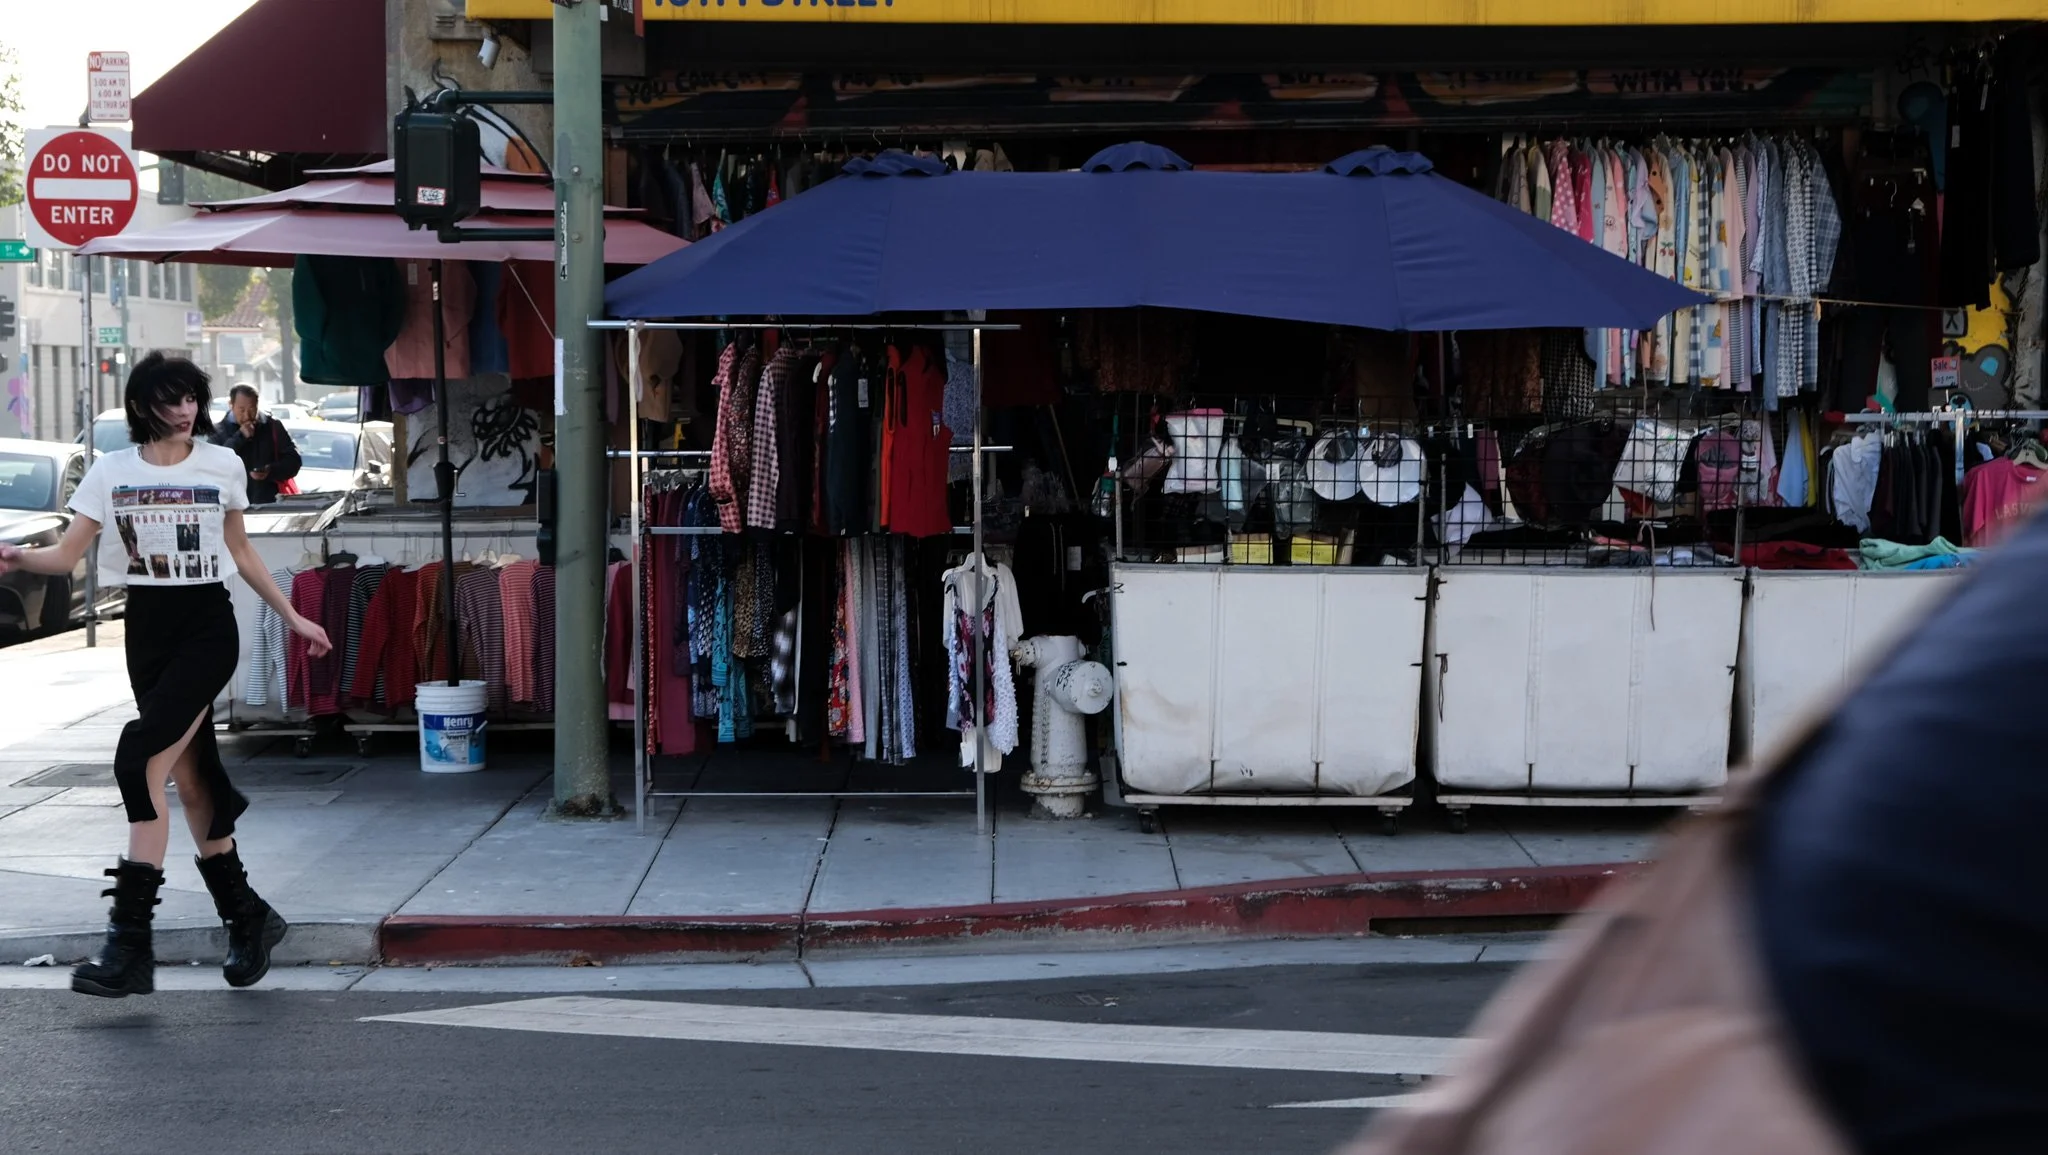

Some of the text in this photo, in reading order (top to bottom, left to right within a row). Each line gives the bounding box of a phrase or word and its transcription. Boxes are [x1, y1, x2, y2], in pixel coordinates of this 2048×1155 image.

[89, 55, 129, 69] NO PARKING
[43, 153, 122, 174] DO NOT
[51, 206, 114, 225] ENTER
[1933, 360, 1948, 371] Sale
[443, 716, 474, 728] Henry
